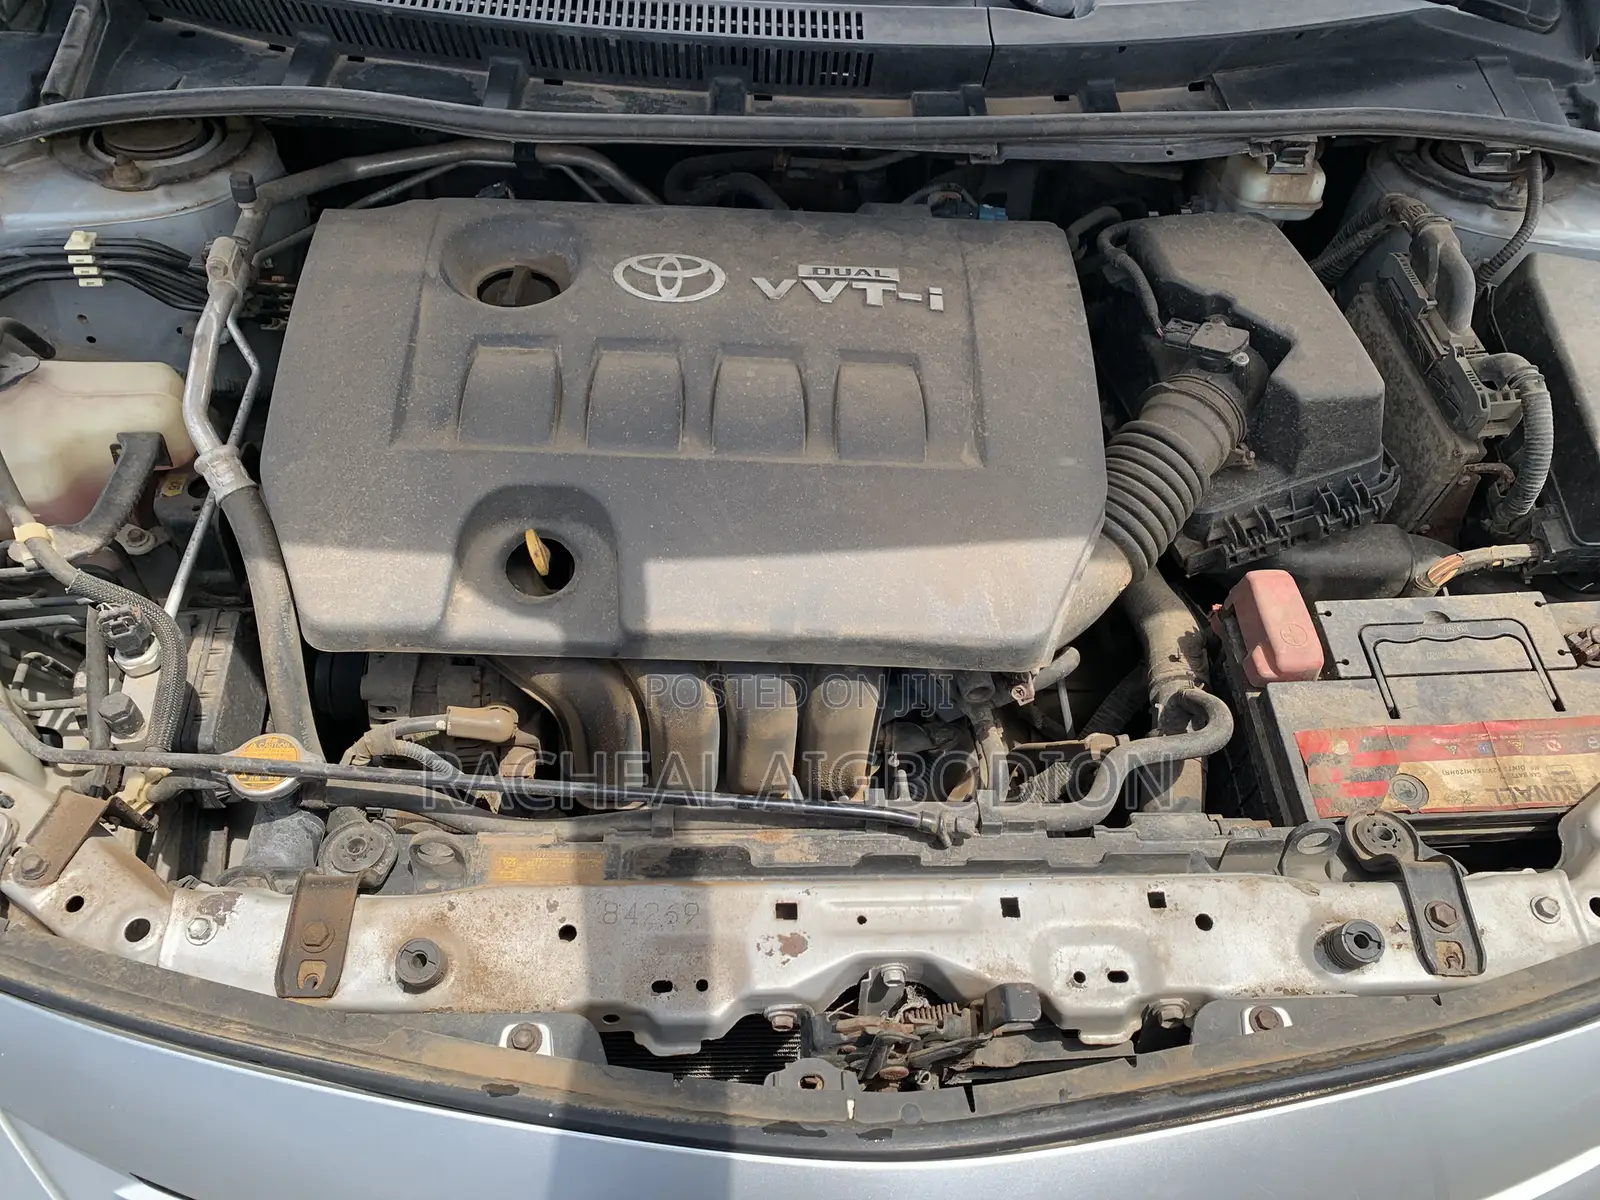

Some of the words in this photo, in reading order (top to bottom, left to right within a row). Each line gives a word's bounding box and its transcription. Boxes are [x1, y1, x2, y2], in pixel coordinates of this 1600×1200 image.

[812, 267, 891, 278] DUAL
[751, 277, 944, 312] VVT-i
[1485, 785, 1584, 804] RUNALL
